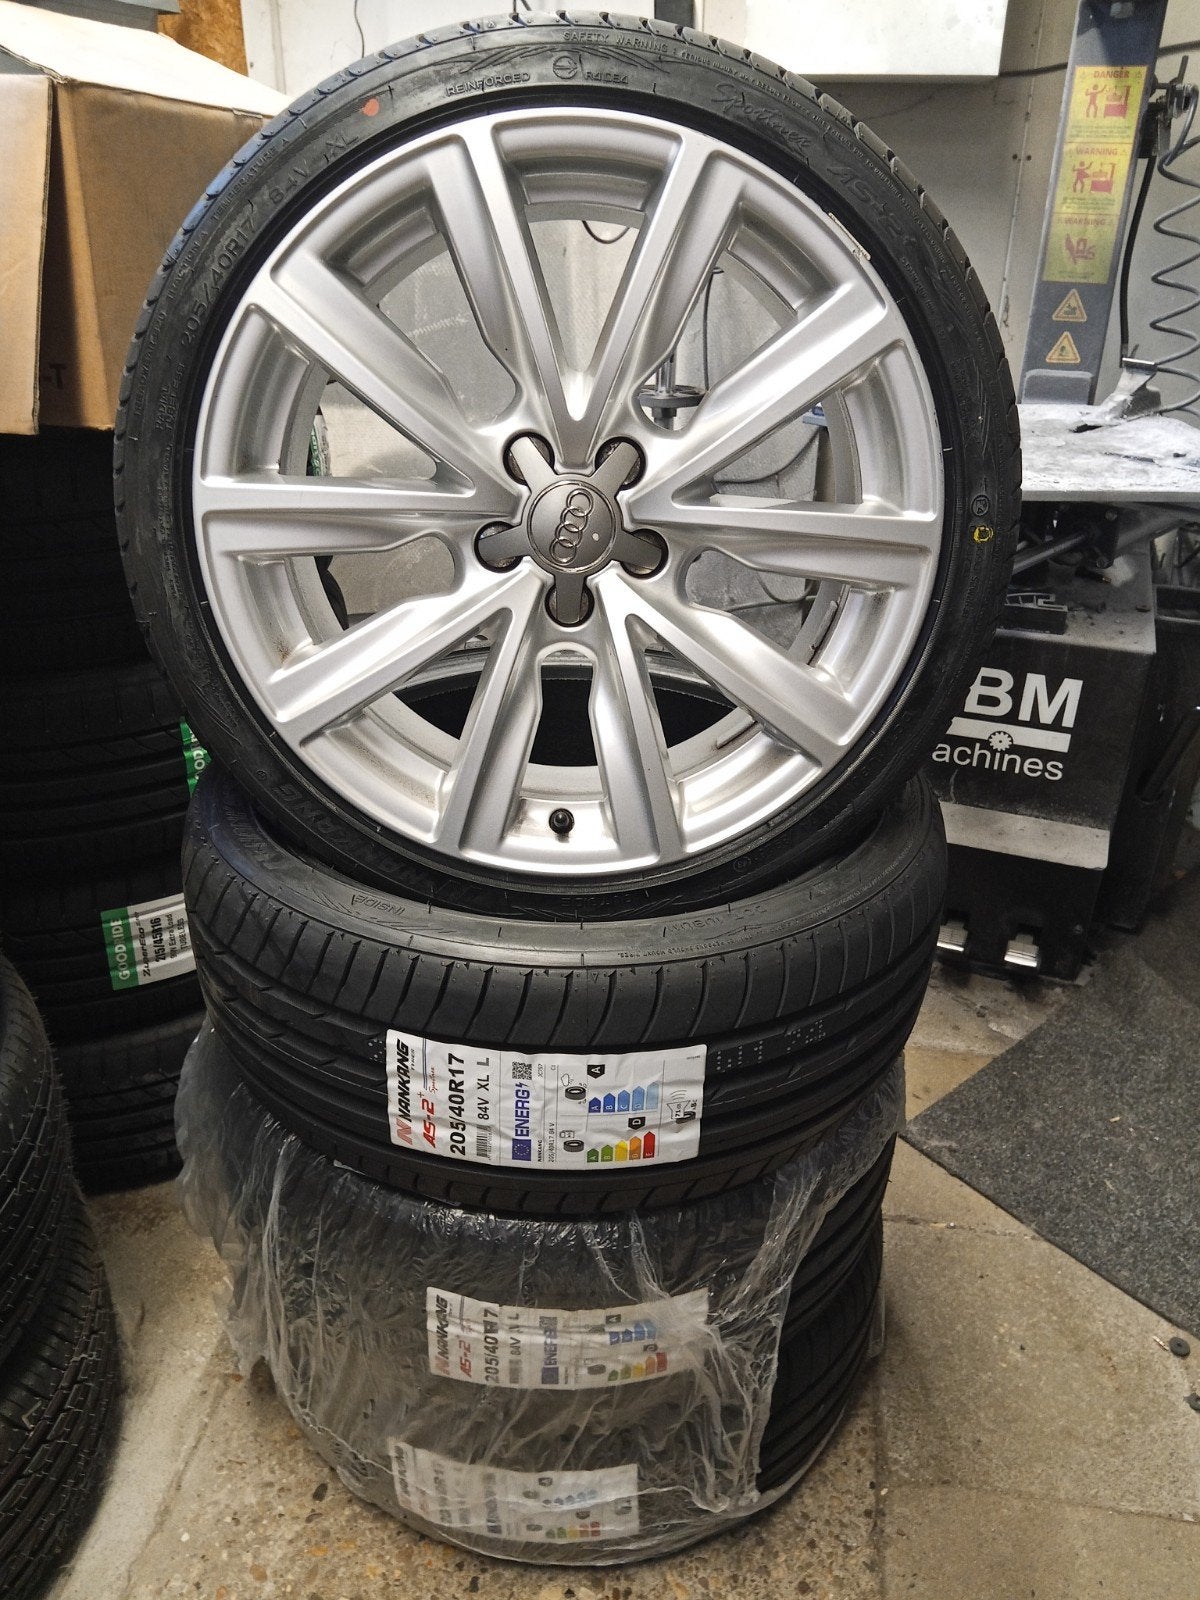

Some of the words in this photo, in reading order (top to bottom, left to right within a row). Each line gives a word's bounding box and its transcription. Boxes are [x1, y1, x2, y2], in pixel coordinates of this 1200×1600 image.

[563, 31, 609, 42] SAFETY
[615, 34, 669, 53] WARNING
[444, 70, 531, 98] REINFORCED
[1093, 70, 1130, 79] DANGER
[1076, 147, 1118, 156] WARNING
[207, 144, 281, 224] TEMPERATURE
[180, 216, 260, 347] 205/40R17
[964, 667, 1084, 728] BM
[931, 743, 1064, 781] achines
[110, 919, 131, 980] GOODRIDE
[477, 1057, 490, 1067] L
[591, 1066, 600, 1074] A
[397, 1038, 412, 1123] NANKANG
[477, 1074, 490, 1092] XL
[448, 1053, 466, 1156] 205/40R17
[477, 1096, 490, 1120] 84V
